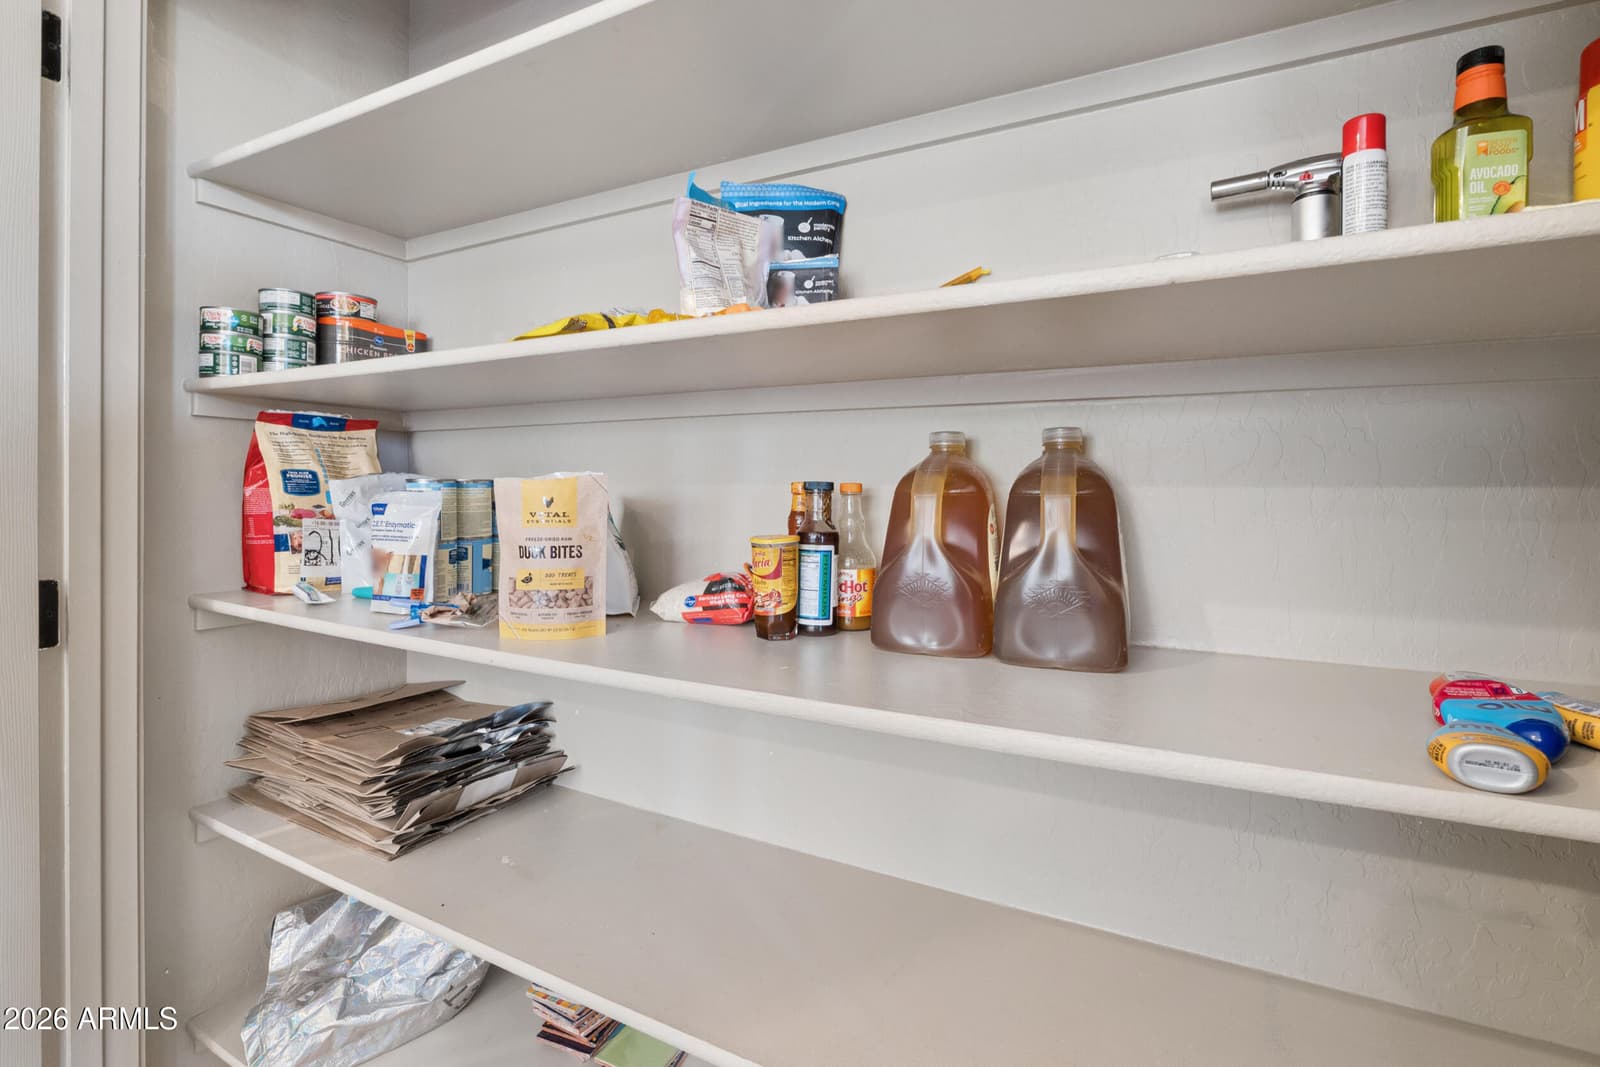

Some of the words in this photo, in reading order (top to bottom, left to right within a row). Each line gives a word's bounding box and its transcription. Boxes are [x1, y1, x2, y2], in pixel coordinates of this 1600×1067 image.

[1470, 163, 1519, 180] AVOCADO
[1469, 181, 1487, 194] OIL
[385, 521, 416, 530] Enzymatic
[518, 545, 546, 559] DUCK
[550, 544, 583, 559] BITES
